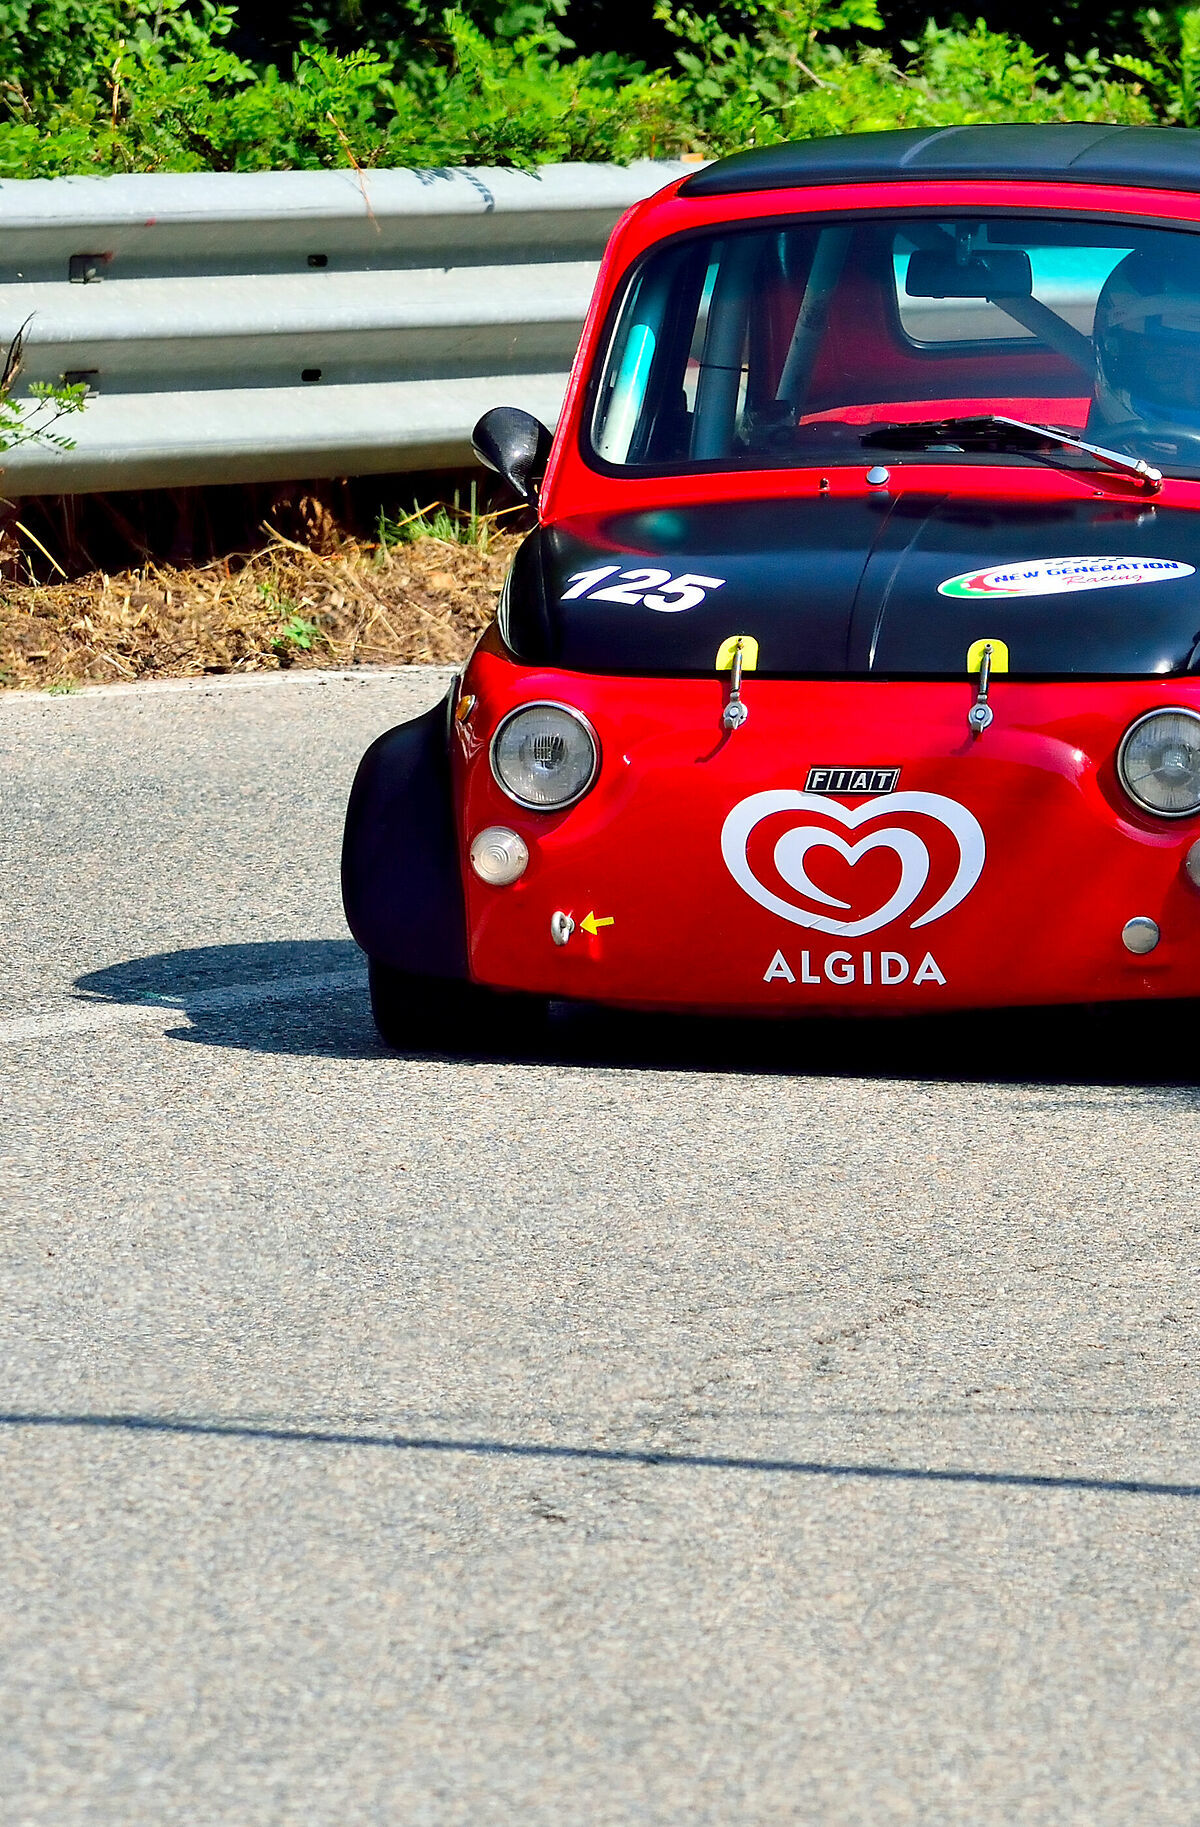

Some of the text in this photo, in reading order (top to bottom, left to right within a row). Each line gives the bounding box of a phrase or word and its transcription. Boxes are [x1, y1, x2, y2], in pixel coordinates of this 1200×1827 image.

[994, 561, 1179, 583] NEW GENERATION
[1062, 574, 1144, 587] Racing
[560, 565, 727, 613] 125
[810, 771, 893, 789] FIAT
[763, 949, 947, 985] ALGIDA
